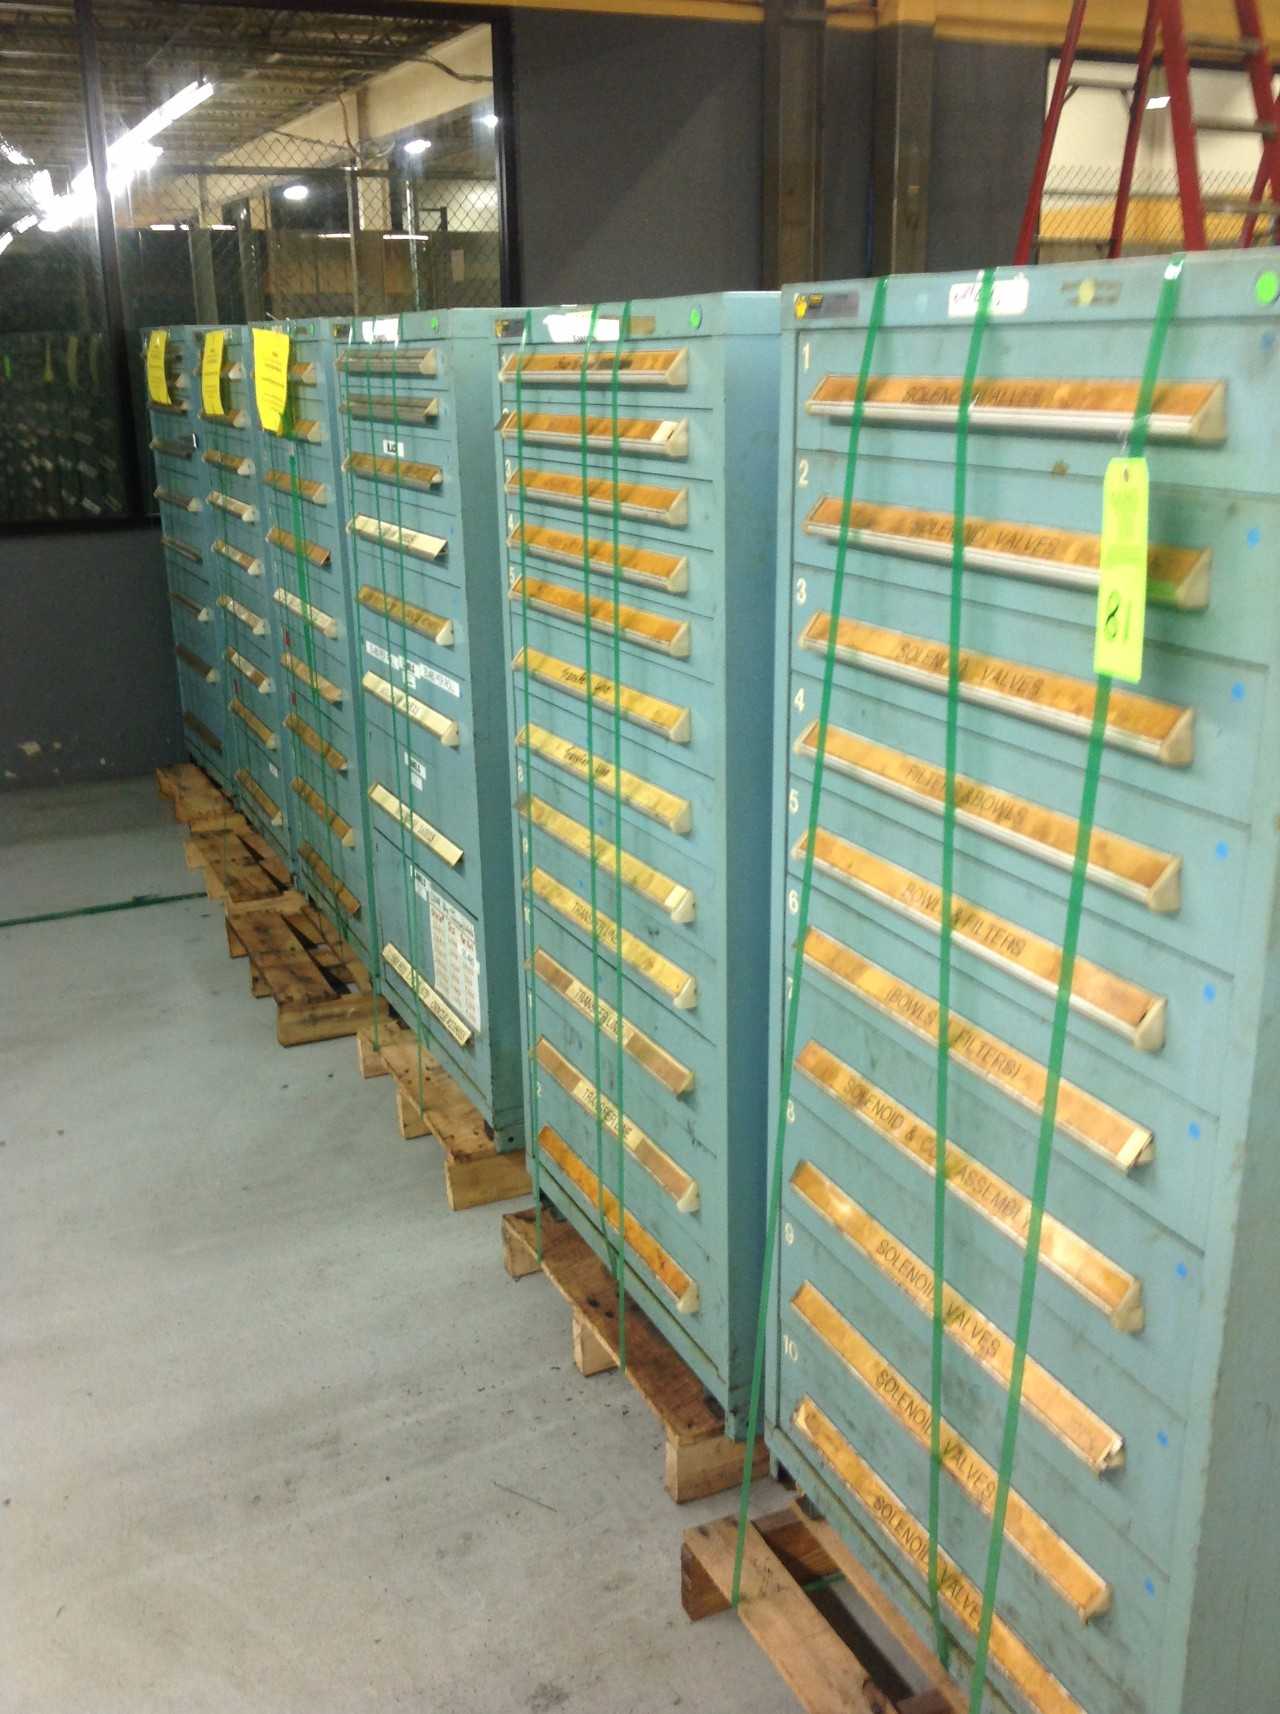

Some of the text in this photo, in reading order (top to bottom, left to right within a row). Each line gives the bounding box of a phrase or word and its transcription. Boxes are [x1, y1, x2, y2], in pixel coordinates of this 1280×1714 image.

[802, 343, 811, 372] 1
[799, 458, 809, 488] 2
[796, 577, 807, 607] 3
[794, 687, 805, 712] 4
[788, 788, 799, 815] 5
[788, 889, 799, 915] 6
[786, 1099, 796, 1124] 8
[945, 1302, 1001, 1358] VALVES
[783, 1333, 799, 1362] 10
[942, 1438, 997, 1500] VALVES
[938, 1564, 987, 1628] VALVE
